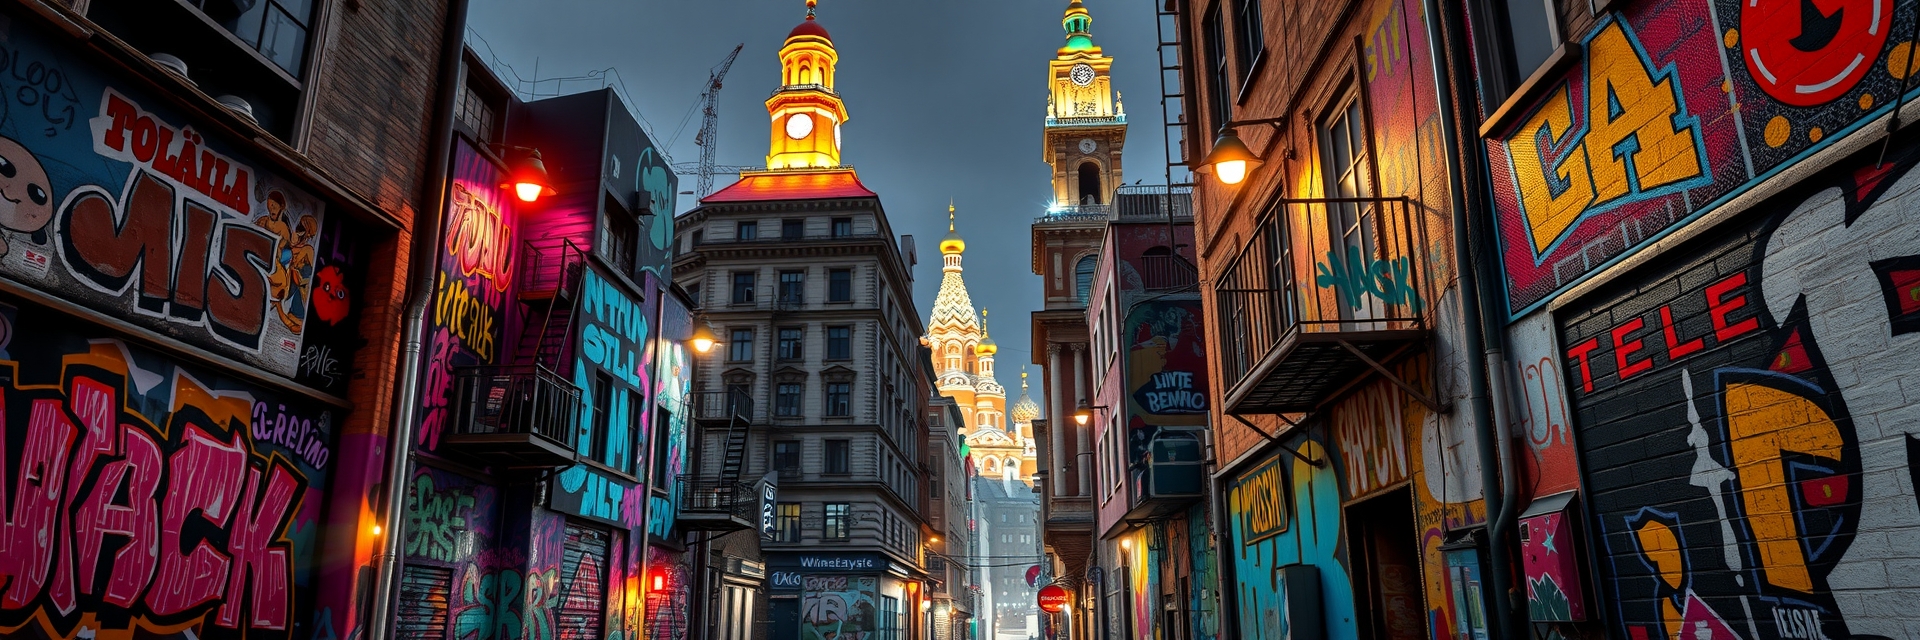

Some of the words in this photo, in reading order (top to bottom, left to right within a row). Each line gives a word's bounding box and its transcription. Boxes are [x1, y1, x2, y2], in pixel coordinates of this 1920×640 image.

[104, 92, 249, 216] TOLÄILA
[1506, 18, 1702, 258] GA
[1567, 272, 1758, 393] TELE
